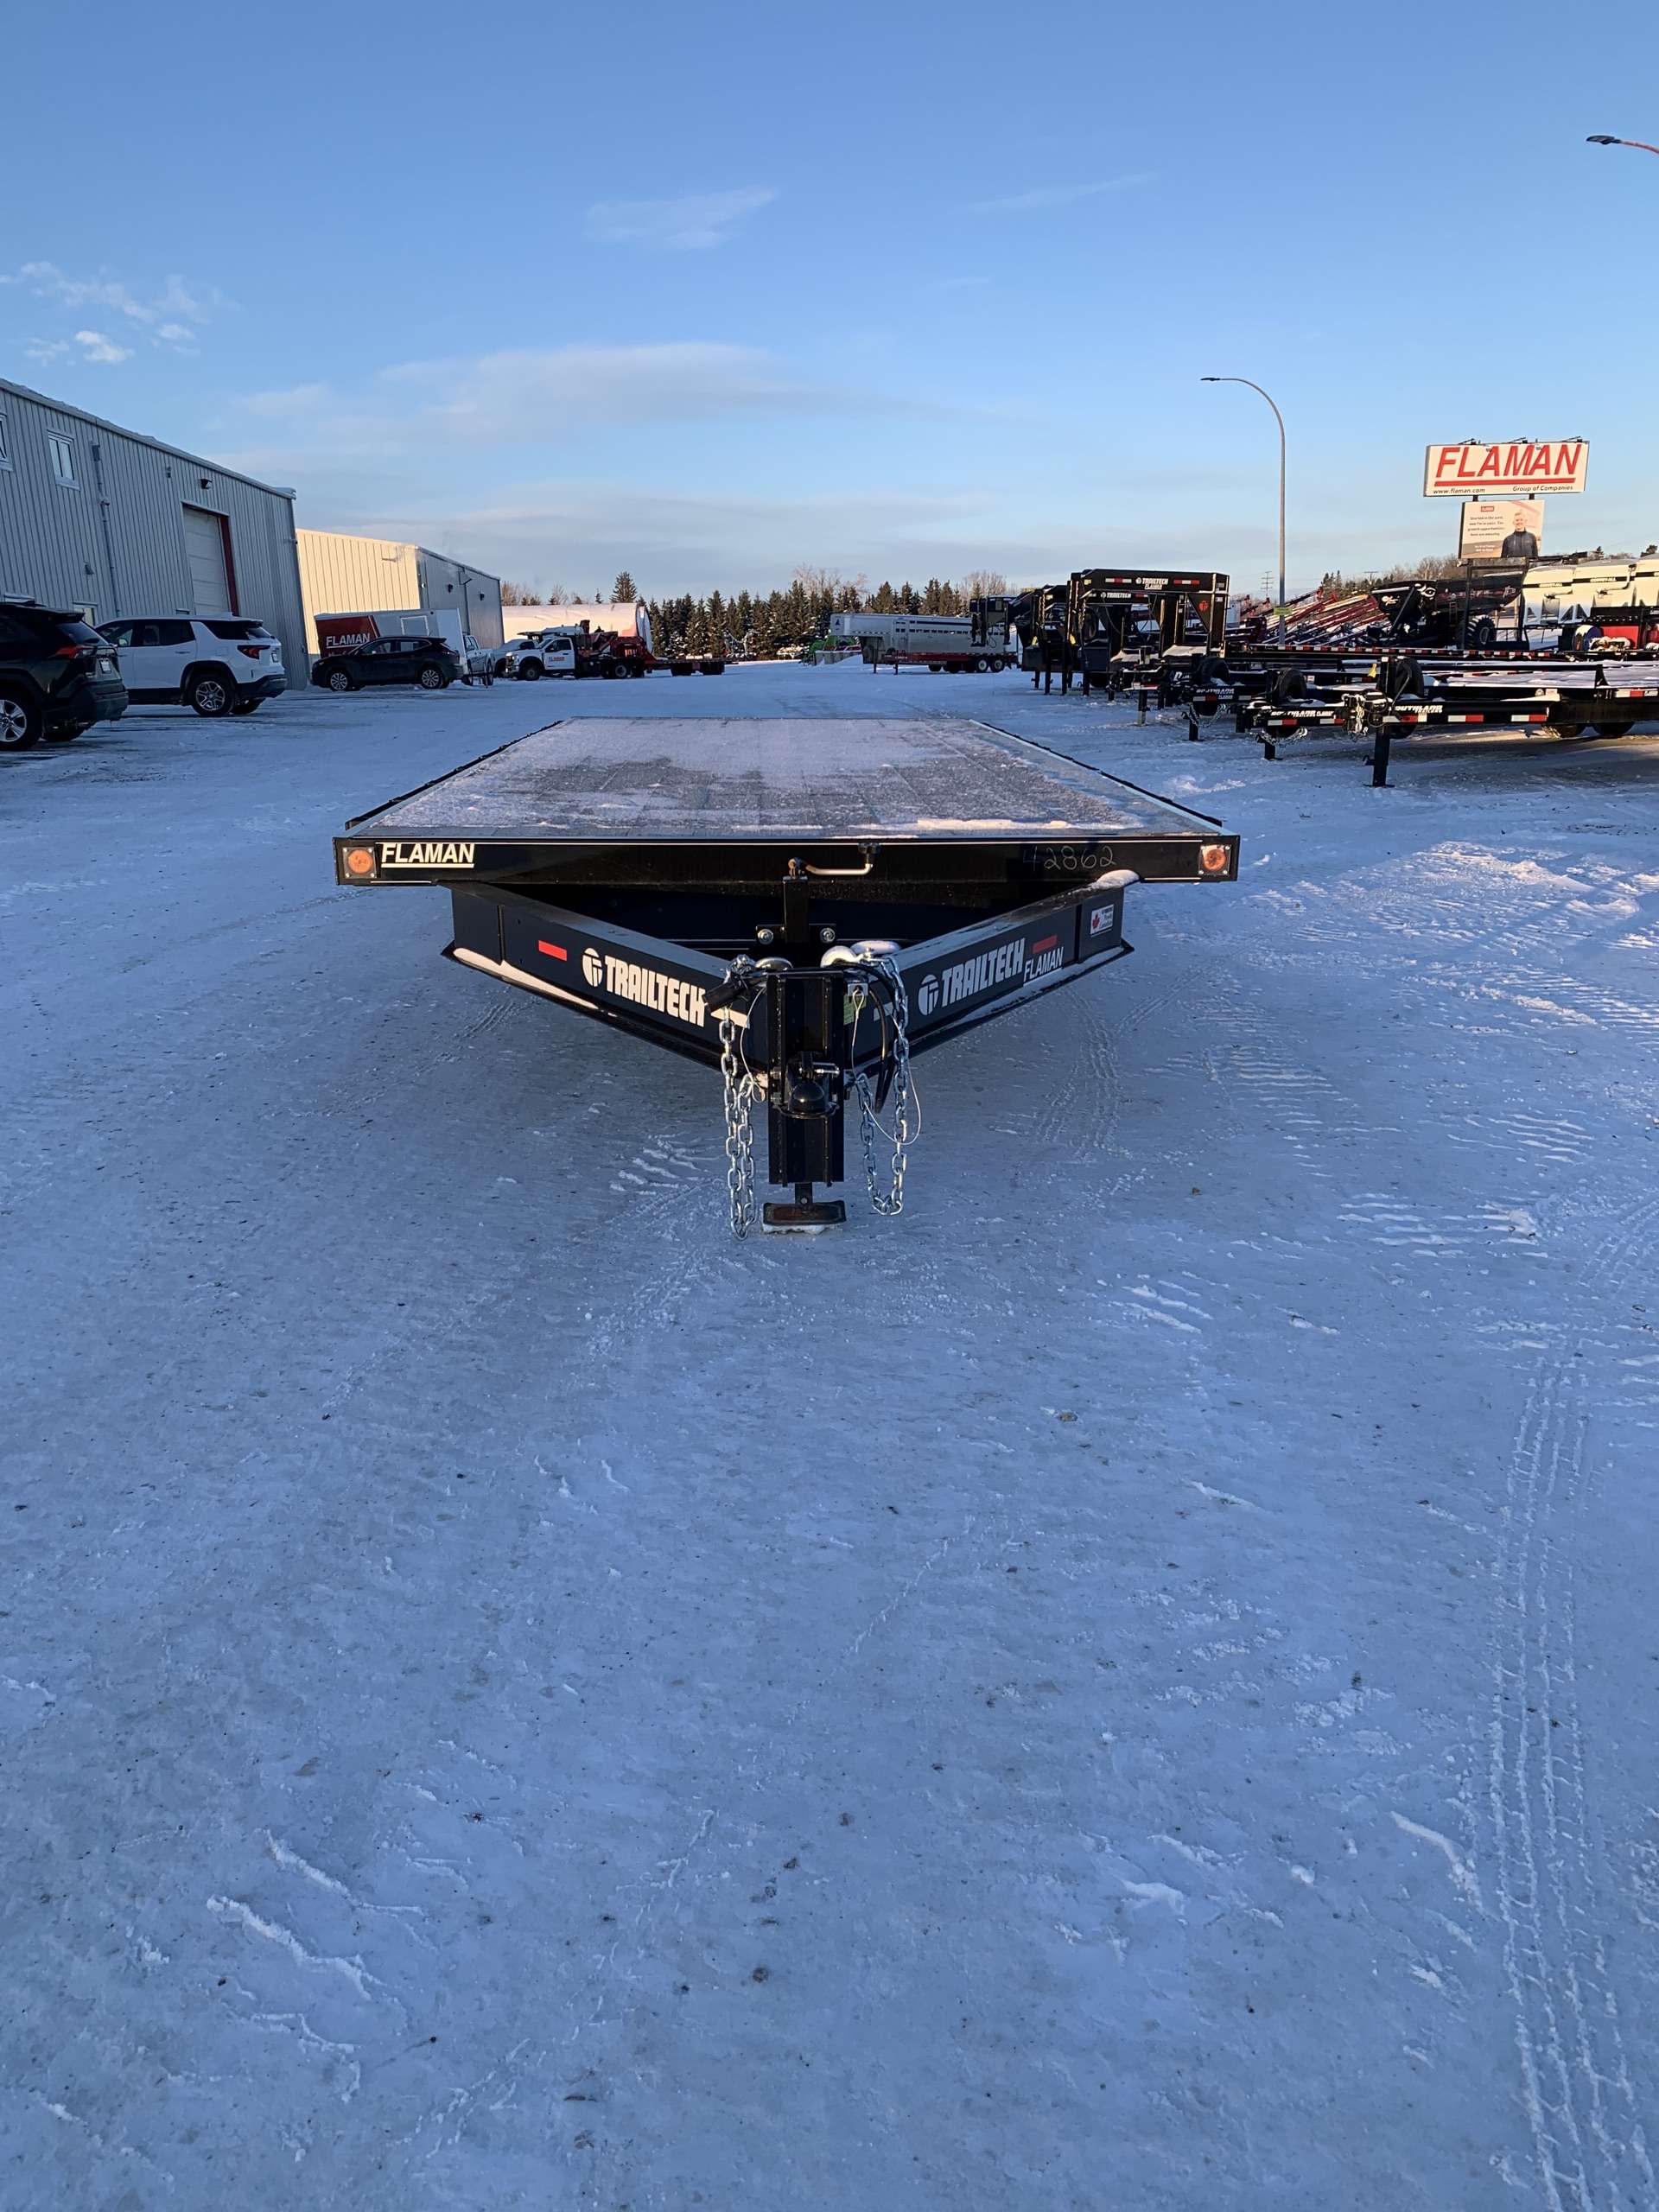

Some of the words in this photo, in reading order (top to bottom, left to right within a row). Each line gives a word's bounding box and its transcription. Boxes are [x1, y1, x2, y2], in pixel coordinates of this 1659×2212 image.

[1436, 444, 1582, 478] FLAMAN
[326, 632, 371, 646] FLAMAN
[381, 842, 475, 863] FLAMAN
[941, 938, 1026, 1007] TRAILTECH
[1023, 946, 1065, 982] FLAMAN
[605, 954, 706, 1027] TRAILTECH
